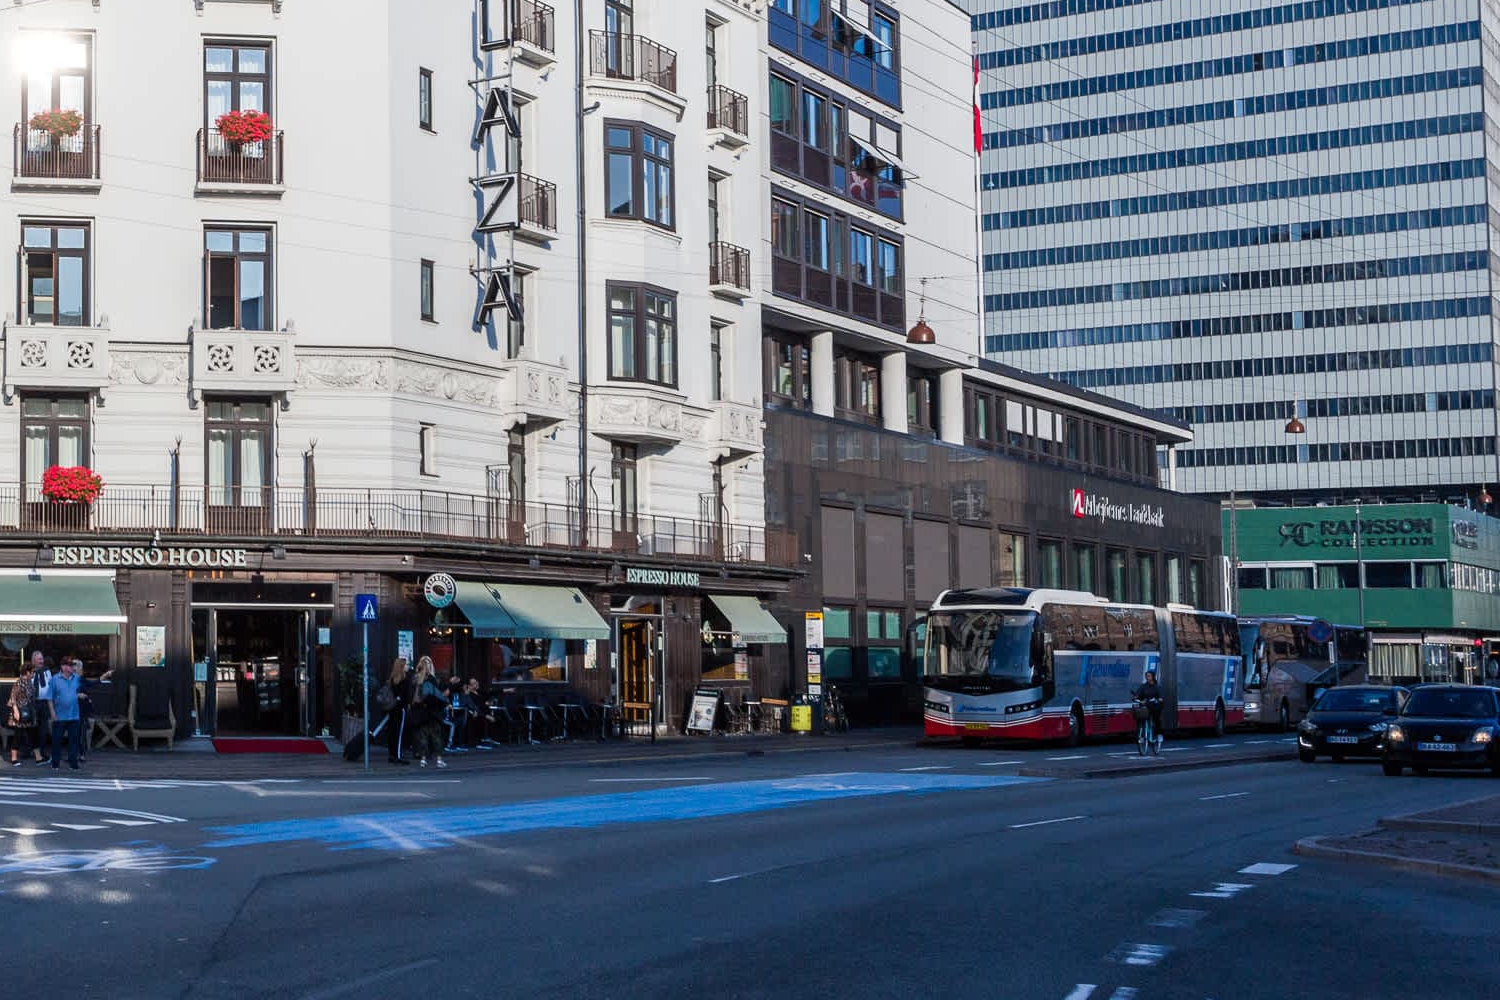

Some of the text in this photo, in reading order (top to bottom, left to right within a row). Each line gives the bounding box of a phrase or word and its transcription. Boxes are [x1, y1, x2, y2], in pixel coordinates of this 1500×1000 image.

[1321, 518, 1433, 536] RADISSON
[53, 546, 247, 567] ESPRESSO HOUSE
[627, 568, 700, 587] ESPRESSO HOUSE
[38, 623, 73, 632] HOUSE
